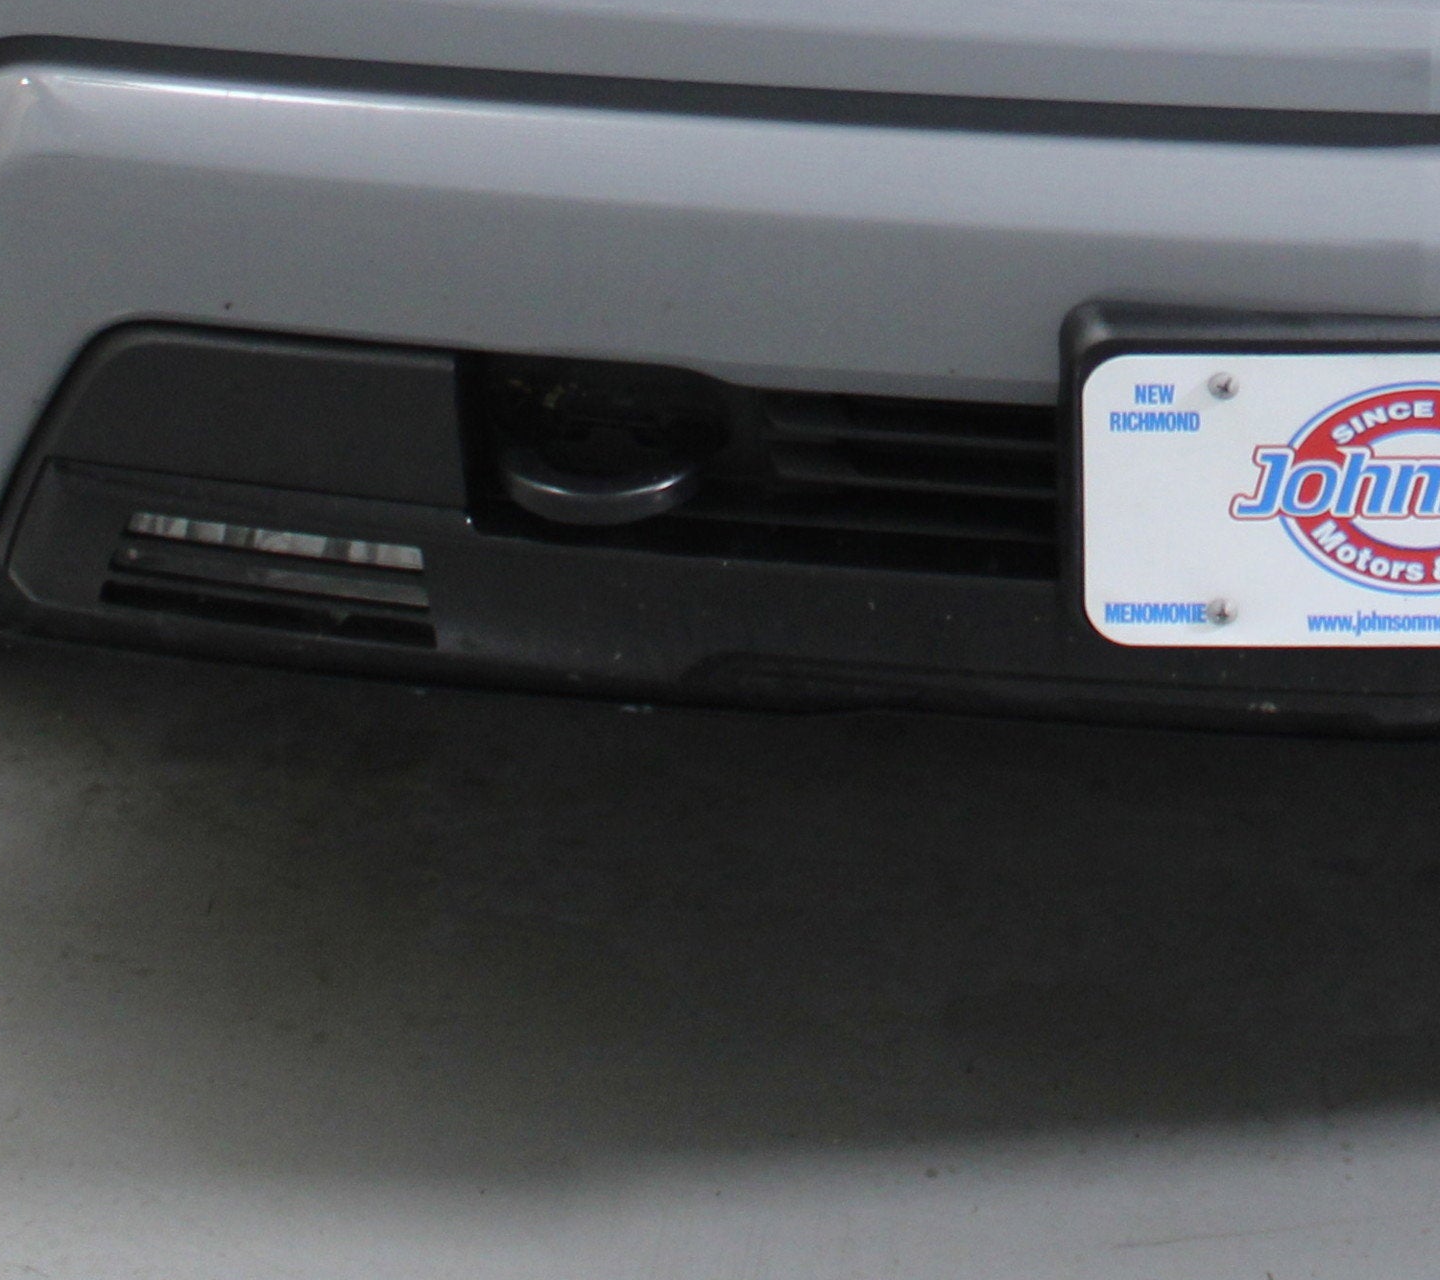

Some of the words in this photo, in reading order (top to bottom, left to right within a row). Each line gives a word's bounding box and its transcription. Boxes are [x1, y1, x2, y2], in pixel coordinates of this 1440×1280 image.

[1134, 384, 1176, 405] NEW
[1109, 411, 1201, 432] RICHMOND
[1330, 399, 1435, 446] SINCE
[1309, 519, 1425, 583] Motors
[1103, 602, 1208, 624] MENOMONIE
